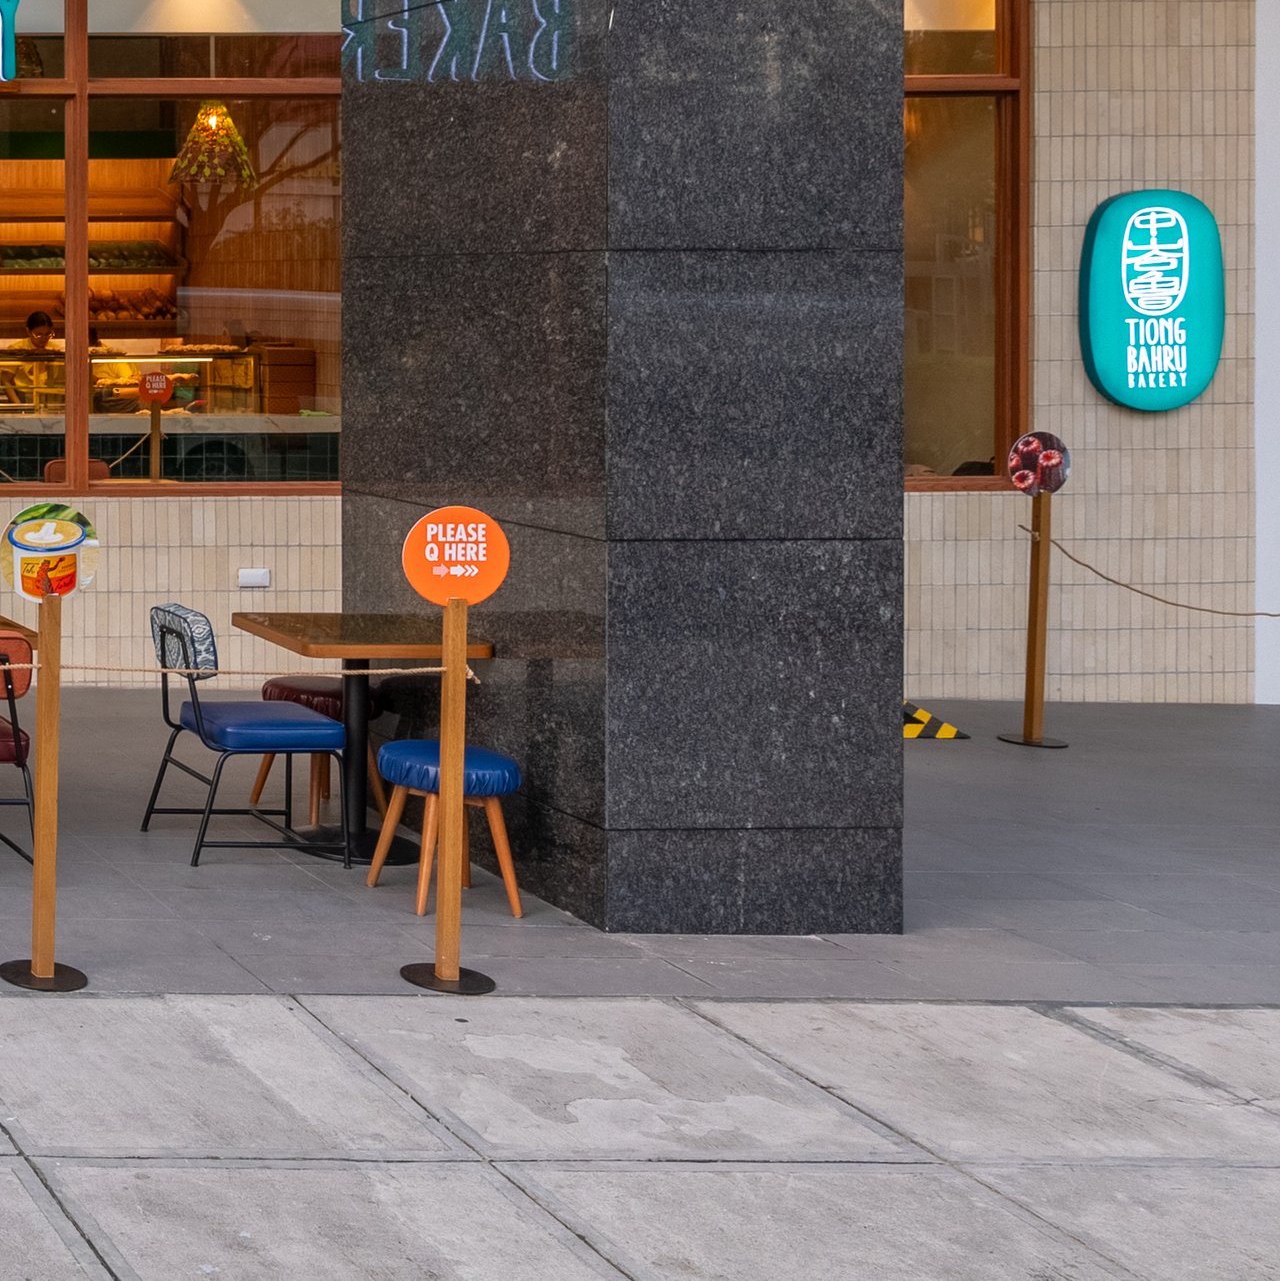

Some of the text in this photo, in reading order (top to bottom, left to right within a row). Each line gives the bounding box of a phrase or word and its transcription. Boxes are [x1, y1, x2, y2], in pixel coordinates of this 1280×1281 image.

[1125, 317, 1186, 345] TIONG
[1127, 345, 1187, 373] BAHRU
[1128, 372, 1187, 388] BAKERY
[426, 523, 487, 542] PLEASE
[425, 543, 488, 561] Q HERE
